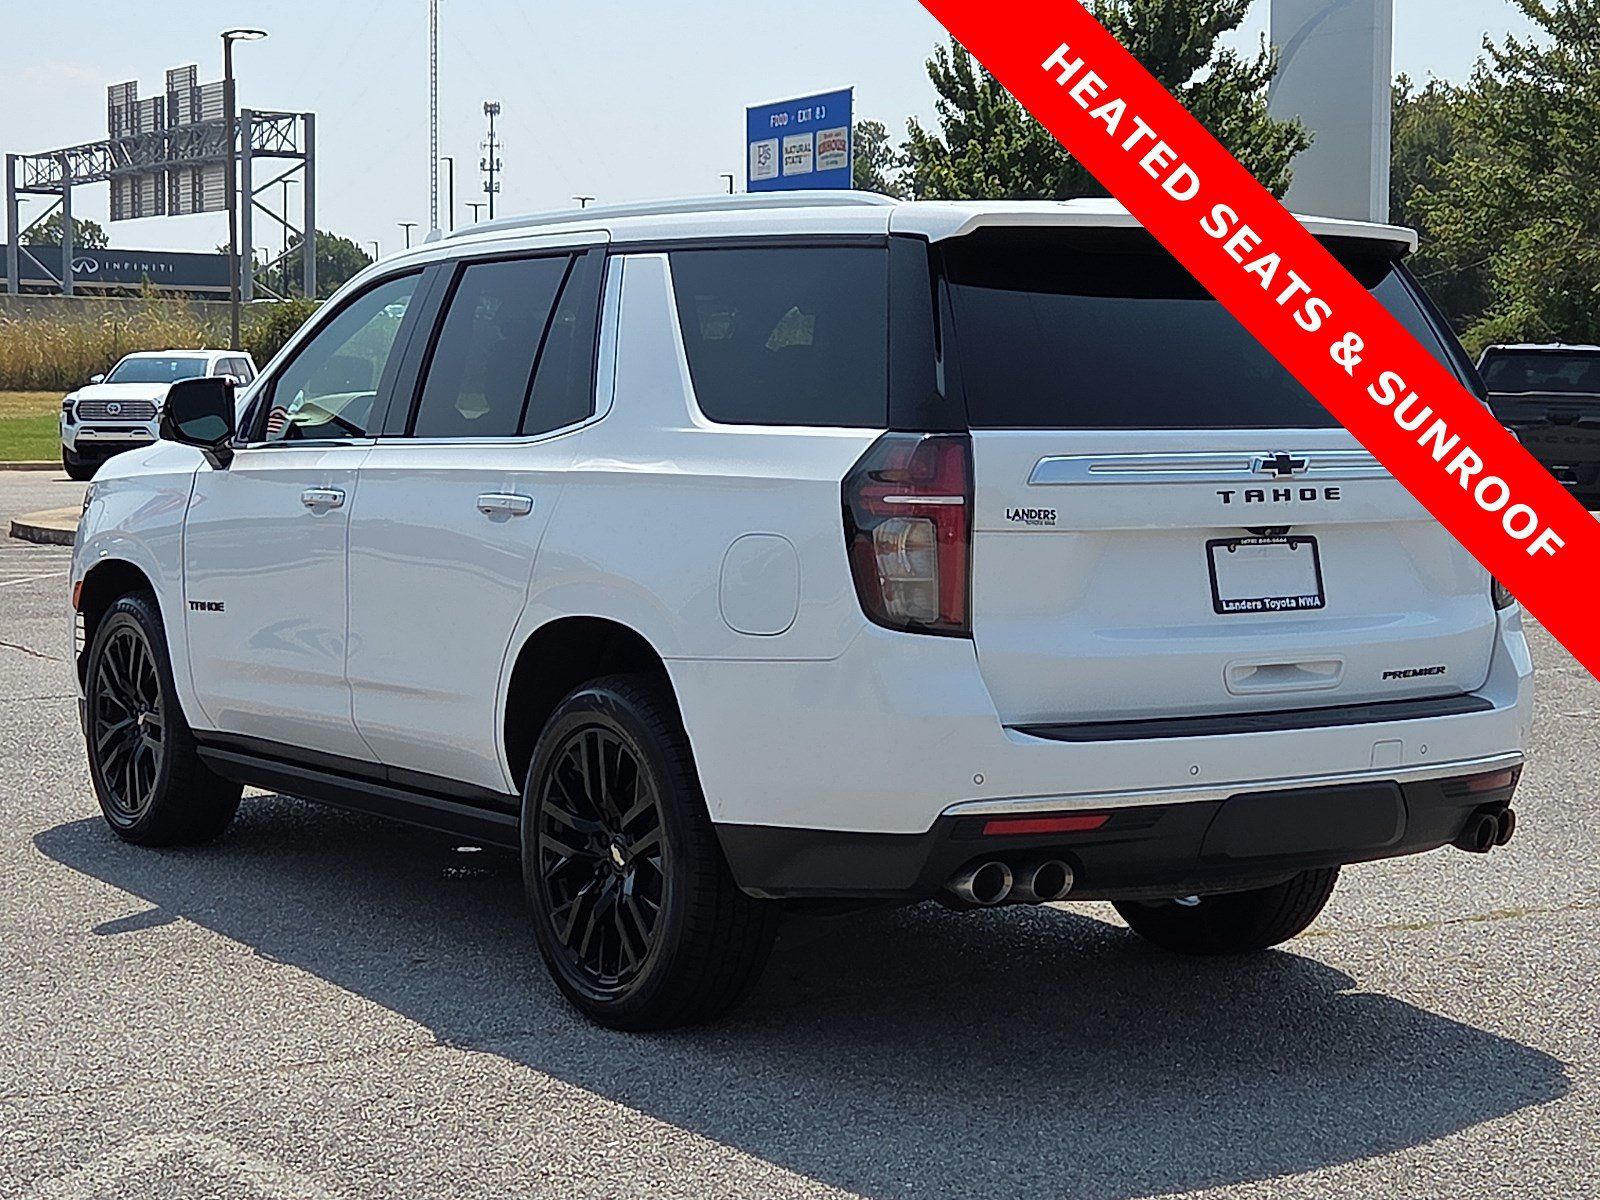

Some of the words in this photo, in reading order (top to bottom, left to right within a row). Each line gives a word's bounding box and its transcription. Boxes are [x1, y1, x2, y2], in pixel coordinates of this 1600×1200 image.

[784, 143, 811, 155] NATURAL
[784, 155, 802, 166] STATE
[105, 262, 173, 273] INFINITI
[1216, 487, 1340, 504] TAHOE
[1006, 508, 1057, 521] LANDERS
[188, 600, 225, 612] TAHOE
[1222, 600, 1262, 611] Landers
[1263, 598, 1296, 610] Toyota
[1298, 596, 1321, 608] NWA
[1382, 665, 1446, 680] PREMIER
